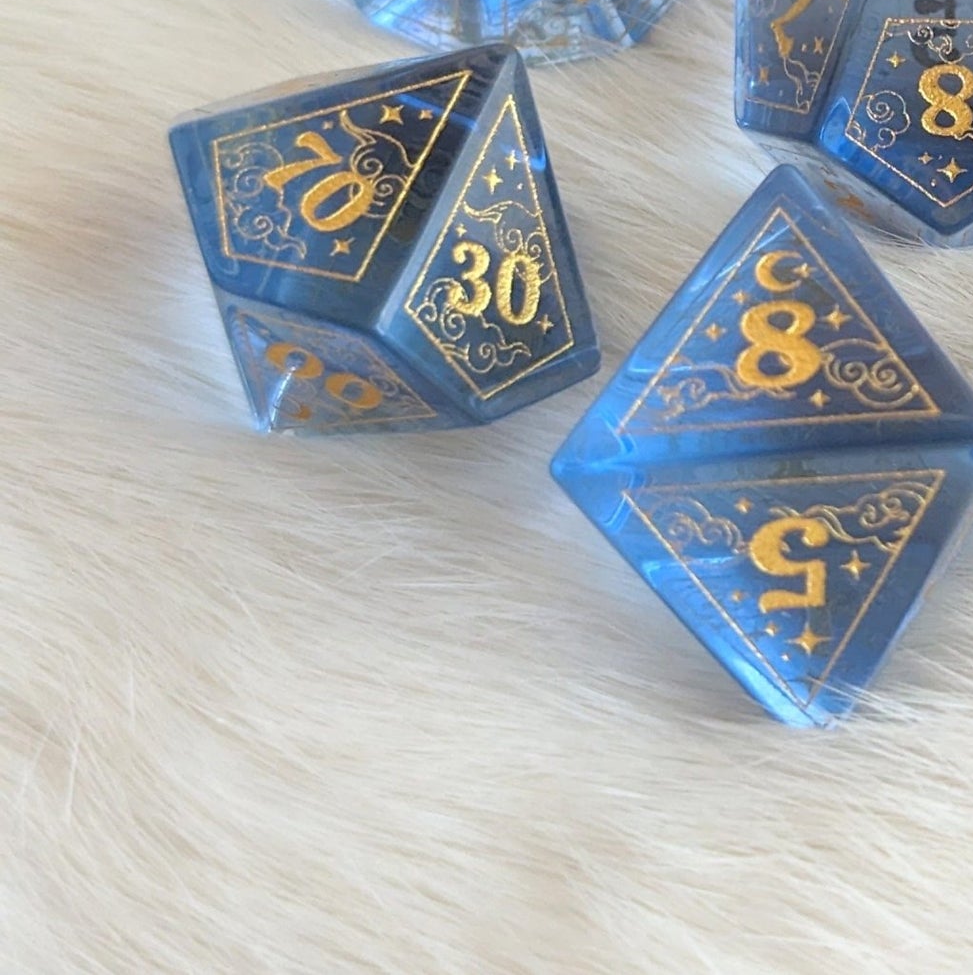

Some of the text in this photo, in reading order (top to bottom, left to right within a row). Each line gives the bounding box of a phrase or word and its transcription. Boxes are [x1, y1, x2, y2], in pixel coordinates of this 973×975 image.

[263, 131, 375, 233] 70
[448, 240, 542, 326] 30
[735, 299, 823, 389] 8
[748, 516, 831, 615] 5
